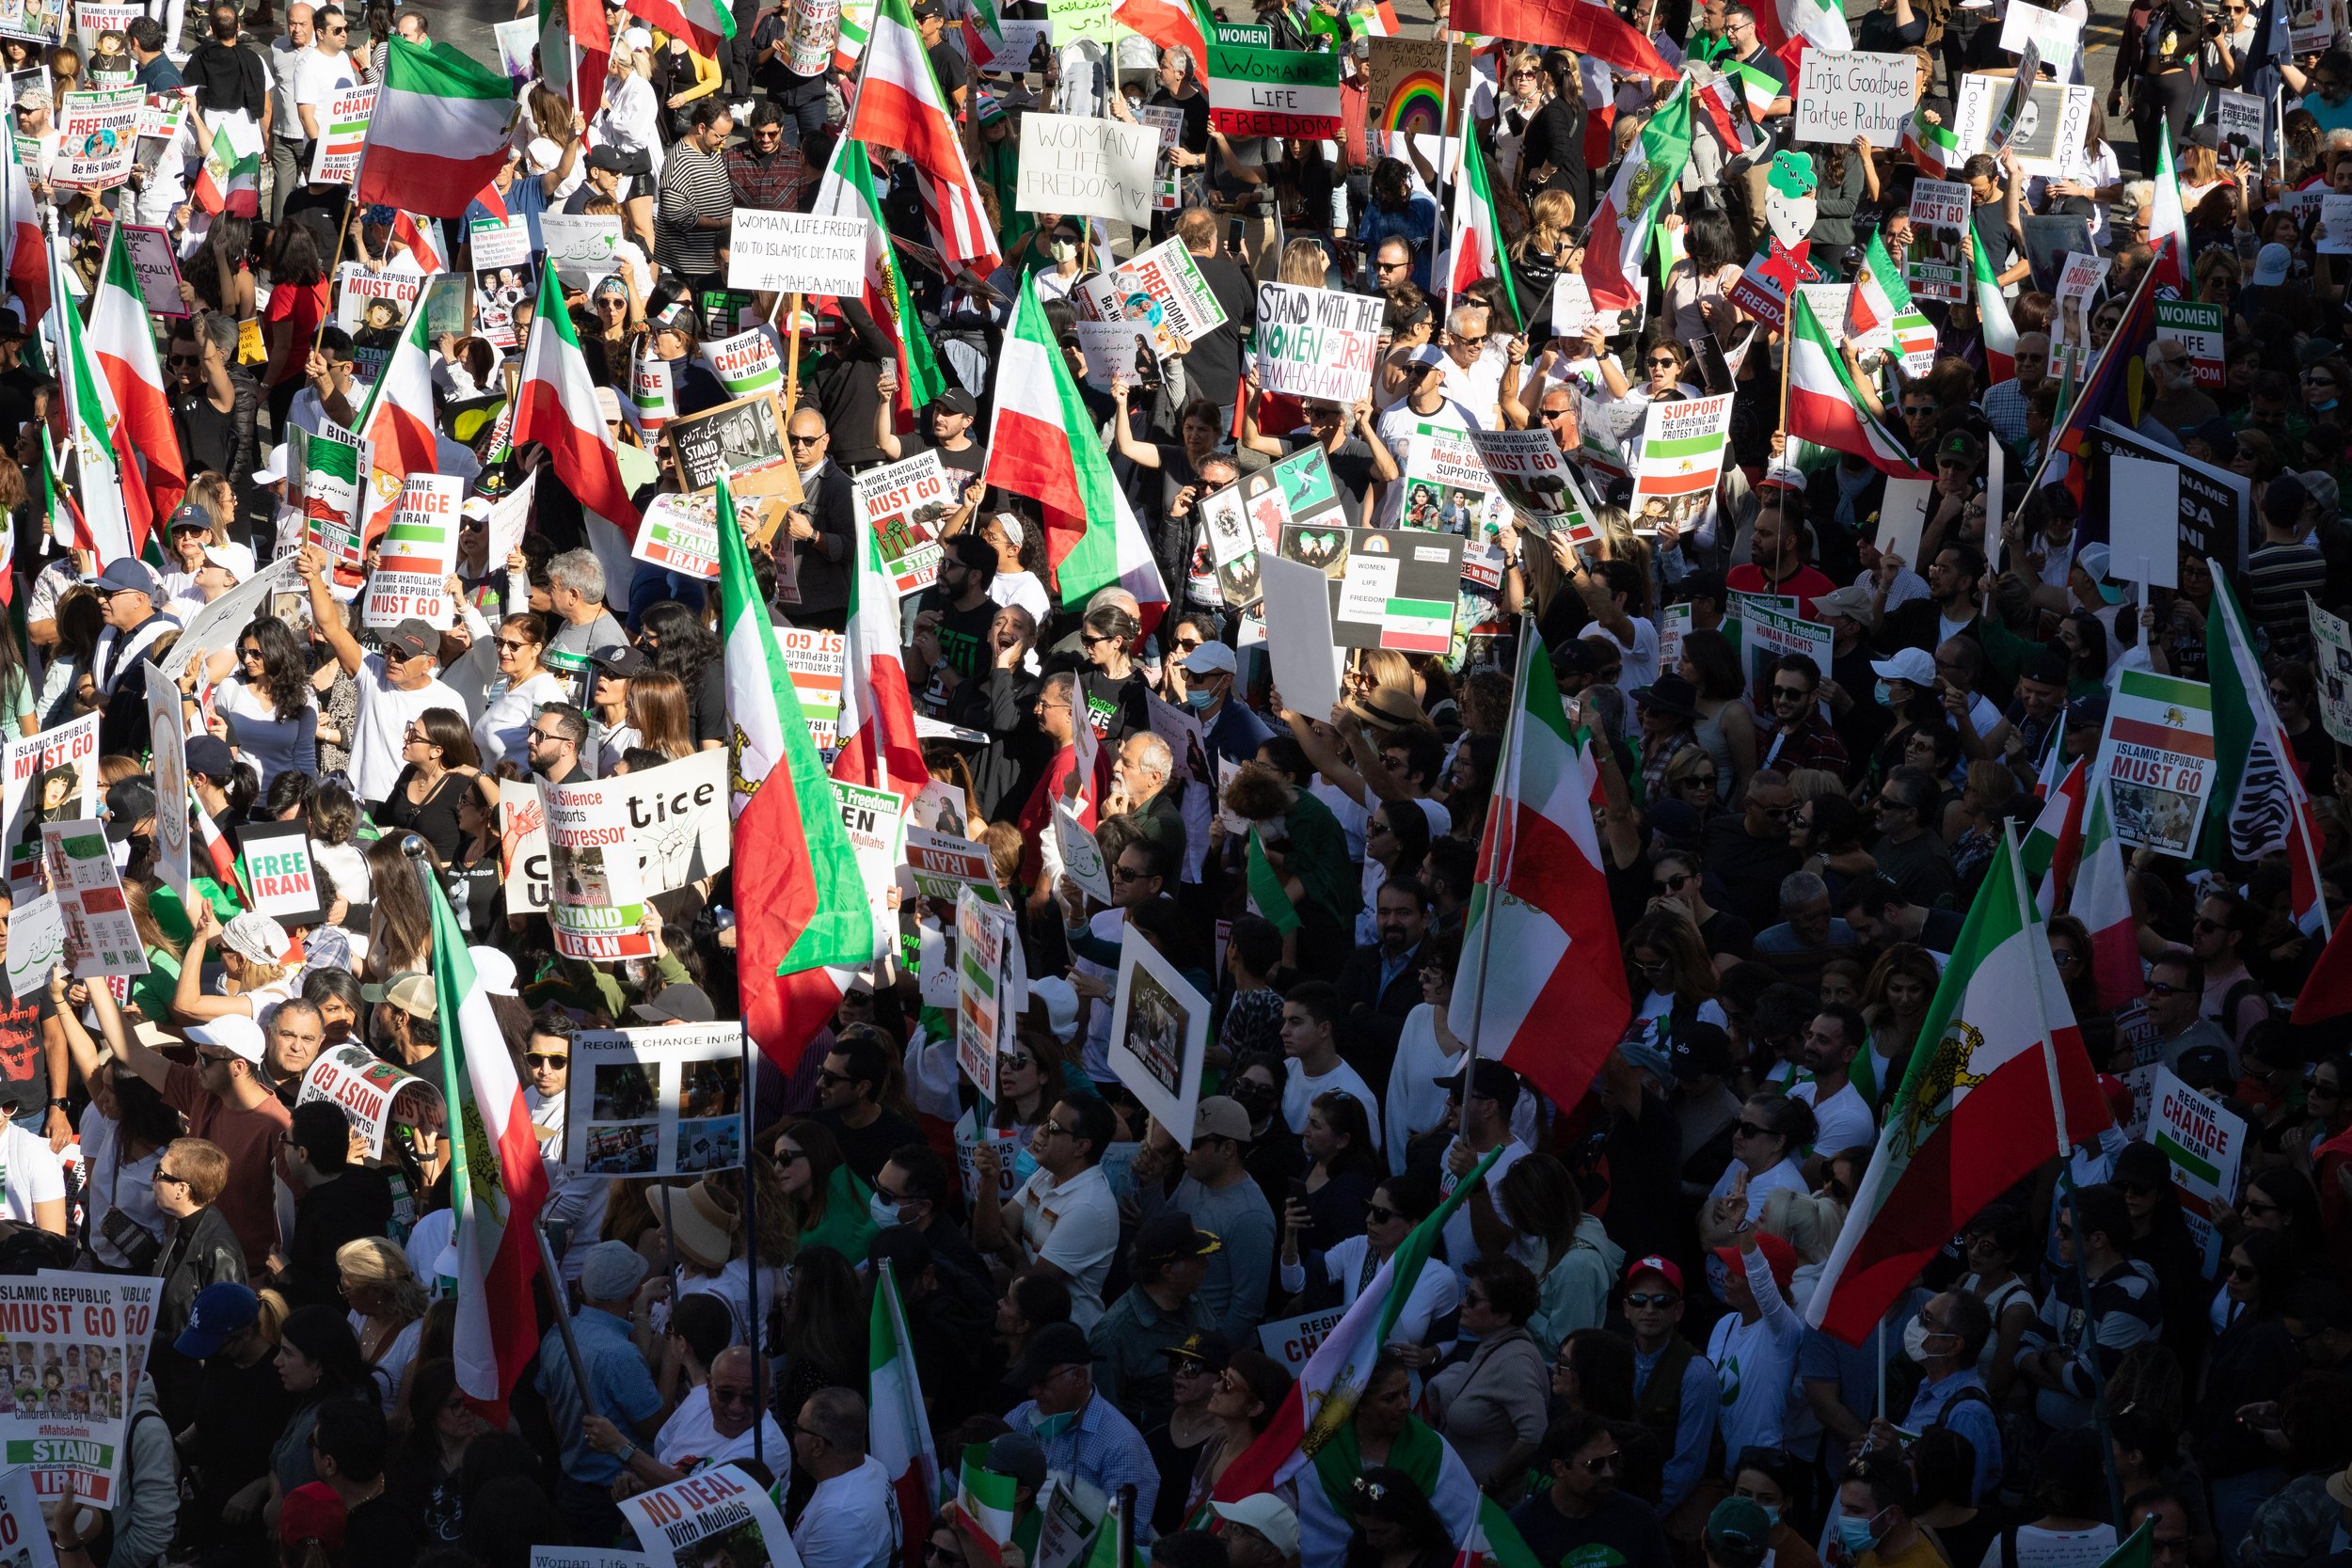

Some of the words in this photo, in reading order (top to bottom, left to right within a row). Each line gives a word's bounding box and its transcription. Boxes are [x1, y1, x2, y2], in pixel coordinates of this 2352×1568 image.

[81, 7, 106, 15] ISLAMIC
[81, 14, 119, 29] MUST
[1218, 28, 1267, 44] WOMEN
[1372, 40, 1382, 50] IN
[1390, 55, 1439, 70] RAINBOW
[1370, 69, 1390, 84] FOR
[1805, 62, 1843, 94] Inja
[1849, 67, 1909, 98] Goodbye
[1252, 87, 1297, 108] LIFE
[1803, 99, 1848, 130] Partye
[2222, 108, 2260, 124] FREEDOM
[2247, 106, 2260, 116] LIFE
[69, 119, 101, 135] FREE
[103, 114, 136, 128] TOOMAJ
[1219, 111, 1336, 138] FREEDOM
[2059, 87, 2087, 178] RONAGHI
[1038, 121, 1139, 160] WOMAN
[72, 164, 84, 174] Be
[86, 163, 99, 173] His
[102, 160, 121, 171] Voice
[1057, 150, 1111, 177] LIFE
[1027, 170, 1124, 206] FREDOM
[1915, 182, 1923, 191] NO
[1923, 182, 1935, 192] MORE
[1936, 195, 1963, 206] REPUBLIC
[1913, 201, 1943, 220] MUST
[1947, 206, 1963, 223] GO
[823, 220, 866, 238] FREEDOM
[734, 241, 748, 254] NO
[752, 241, 763, 254] TO
[766, 242, 808, 259] ISLAMIC
[810, 246, 856, 261] DICTATOR
[1771, 238, 1815, 279] FREEDOM
[352, 269, 380, 279] ISLAMIC
[382, 273, 416, 284] REPUBLIC
[1920, 265, 1953, 280] STAND
[349, 278, 391, 297] MUST
[397, 284, 417, 301] GO
[1136, 261, 1171, 300] FREE
[1162, 294, 1193, 337] TOOMAJ
[1922, 282, 1949, 296] IRAN
[1101, 295, 1113, 310] Be
[1258, 283, 1310, 325] STAND
[1355, 298, 1383, 333] THE
[2158, 306, 2217, 326] WOMEN
[715, 340, 776, 372] CHANGE
[726, 337, 760, 354] REGIME
[1257, 321, 1325, 364] WOMEN
[1331, 330, 1379, 373] IRAN
[733, 371, 743, 379] in
[746, 361, 768, 375] IRAN
[1663, 398, 1725, 420] SUPPORT
[1661, 420, 1675, 430] THE
[1677, 417, 1706, 429] UPRISING
[1708, 413, 1720, 423] AND
[1661, 429, 1692, 440] PROTEST
[1693, 427, 1700, 436] IN
[1702, 424, 1717, 436] IRAN
[326, 424, 366, 453] BIDEN
[1480, 442, 1509, 452] ISLAMIC
[1510, 443, 1549, 453] REPUBLIC
[1482, 433, 1502, 444] MORE
[1502, 433, 1549, 444] AYATOLLAHS
[685, 439, 718, 460] STAND
[1431, 447, 1461, 466] Media
[865, 472, 887, 486] MORE
[888, 454, 935, 479] AYATOLLAHS
[1482, 451, 1527, 470] MUST
[1531, 452, 1558, 471] GO
[895, 467, 934, 488] REPUBLIC
[1425, 472, 1437, 481] The
[1436, 464, 1490, 483] SUPPORTS
[915, 477, 941, 499] GO
[2180, 473, 2229, 507] NAME
[402, 512, 430, 524] IRAN
[320, 521, 349, 543] STAND
[665, 530, 719, 554] STAND
[321, 537, 344, 555] IRAN
[1467, 540, 1484, 553] Kian
[663, 549, 709, 574] IRAN
[1357, 562, 1386, 571] WOMEN
[375, 573, 386, 583] NO
[386, 574, 397, 584] MORE
[398, 575, 442, 587] AYATOLLAHS
[1361, 578, 1377, 587] LIFE
[1471, 566, 1480, 577] in
[1480, 569, 1500, 584] IRAN
[399, 586, 439, 596] REPUBLIC
[1349, 594, 1385, 603] FREEDOM
[371, 594, 408, 614] MUST
[416, 598, 440, 616] GO
[1756, 624, 1783, 643] HUMAN
[1785, 634, 1814, 653] RIGHTS
[1791, 622, 1831, 643] Freedom.
[1769, 641, 1781, 654] FOR
[15, 737, 52, 758] ISLAMIC
[54, 721, 92, 747] REPUBLIC
[14, 745, 65, 781] MUST
[72, 733, 93, 758] GO
[2117, 742, 2160, 762] ISLAMIC
[2162, 752, 2205, 770] REPUBLIC
[2110, 754, 2173, 787] MUST
[2175, 768, 2202, 794] GO
[559, 790, 603, 807] Silence
[847, 788, 898, 816] Freedom.
[551, 826, 627, 847] Oppressor
[851, 832, 885, 850] Mullahs
[252, 851, 306, 878] FREE
[922, 848, 968, 876] IRAN
[256, 873, 310, 897] IRAN
[557, 906, 622, 928] STAND
[563, 934, 621, 956] IRAN
[583, 1039, 640, 1051] REGIME
[643, 1037, 703, 1049] CHANGE
[707, 1035, 722, 1046] IN
[312, 1063, 339, 1091] GO
[335, 1077, 383, 1122] MUST
[2178, 1088, 2217, 1123] REGIME
[2163, 1095, 2228, 1156] CHANGE
[2171, 1128, 2180, 1142] in
[2183, 1132, 2209, 1160] IRAN
[53, 1287, 111, 1305] REPUBLIC
[0, 1303, 72, 1335] MUST
[85, 1306, 116, 1338] GO
[124, 1305, 151, 1336] GO
[190, 1306, 200, 1329] LA
[15, 1408, 50, 1420] Children
[71, 1412, 83, 1423] By
[39, 1424, 90, 1438] #MahsaAmini
[32, 1439, 102, 1465] STAND
[37, 1464, 65, 1472] Solidarity
[638, 1491, 683, 1528] NO
[675, 1471, 746, 1512] DEAL
[664, 1522, 699, 1548] With
[696, 1499, 752, 1537] Mullahs
